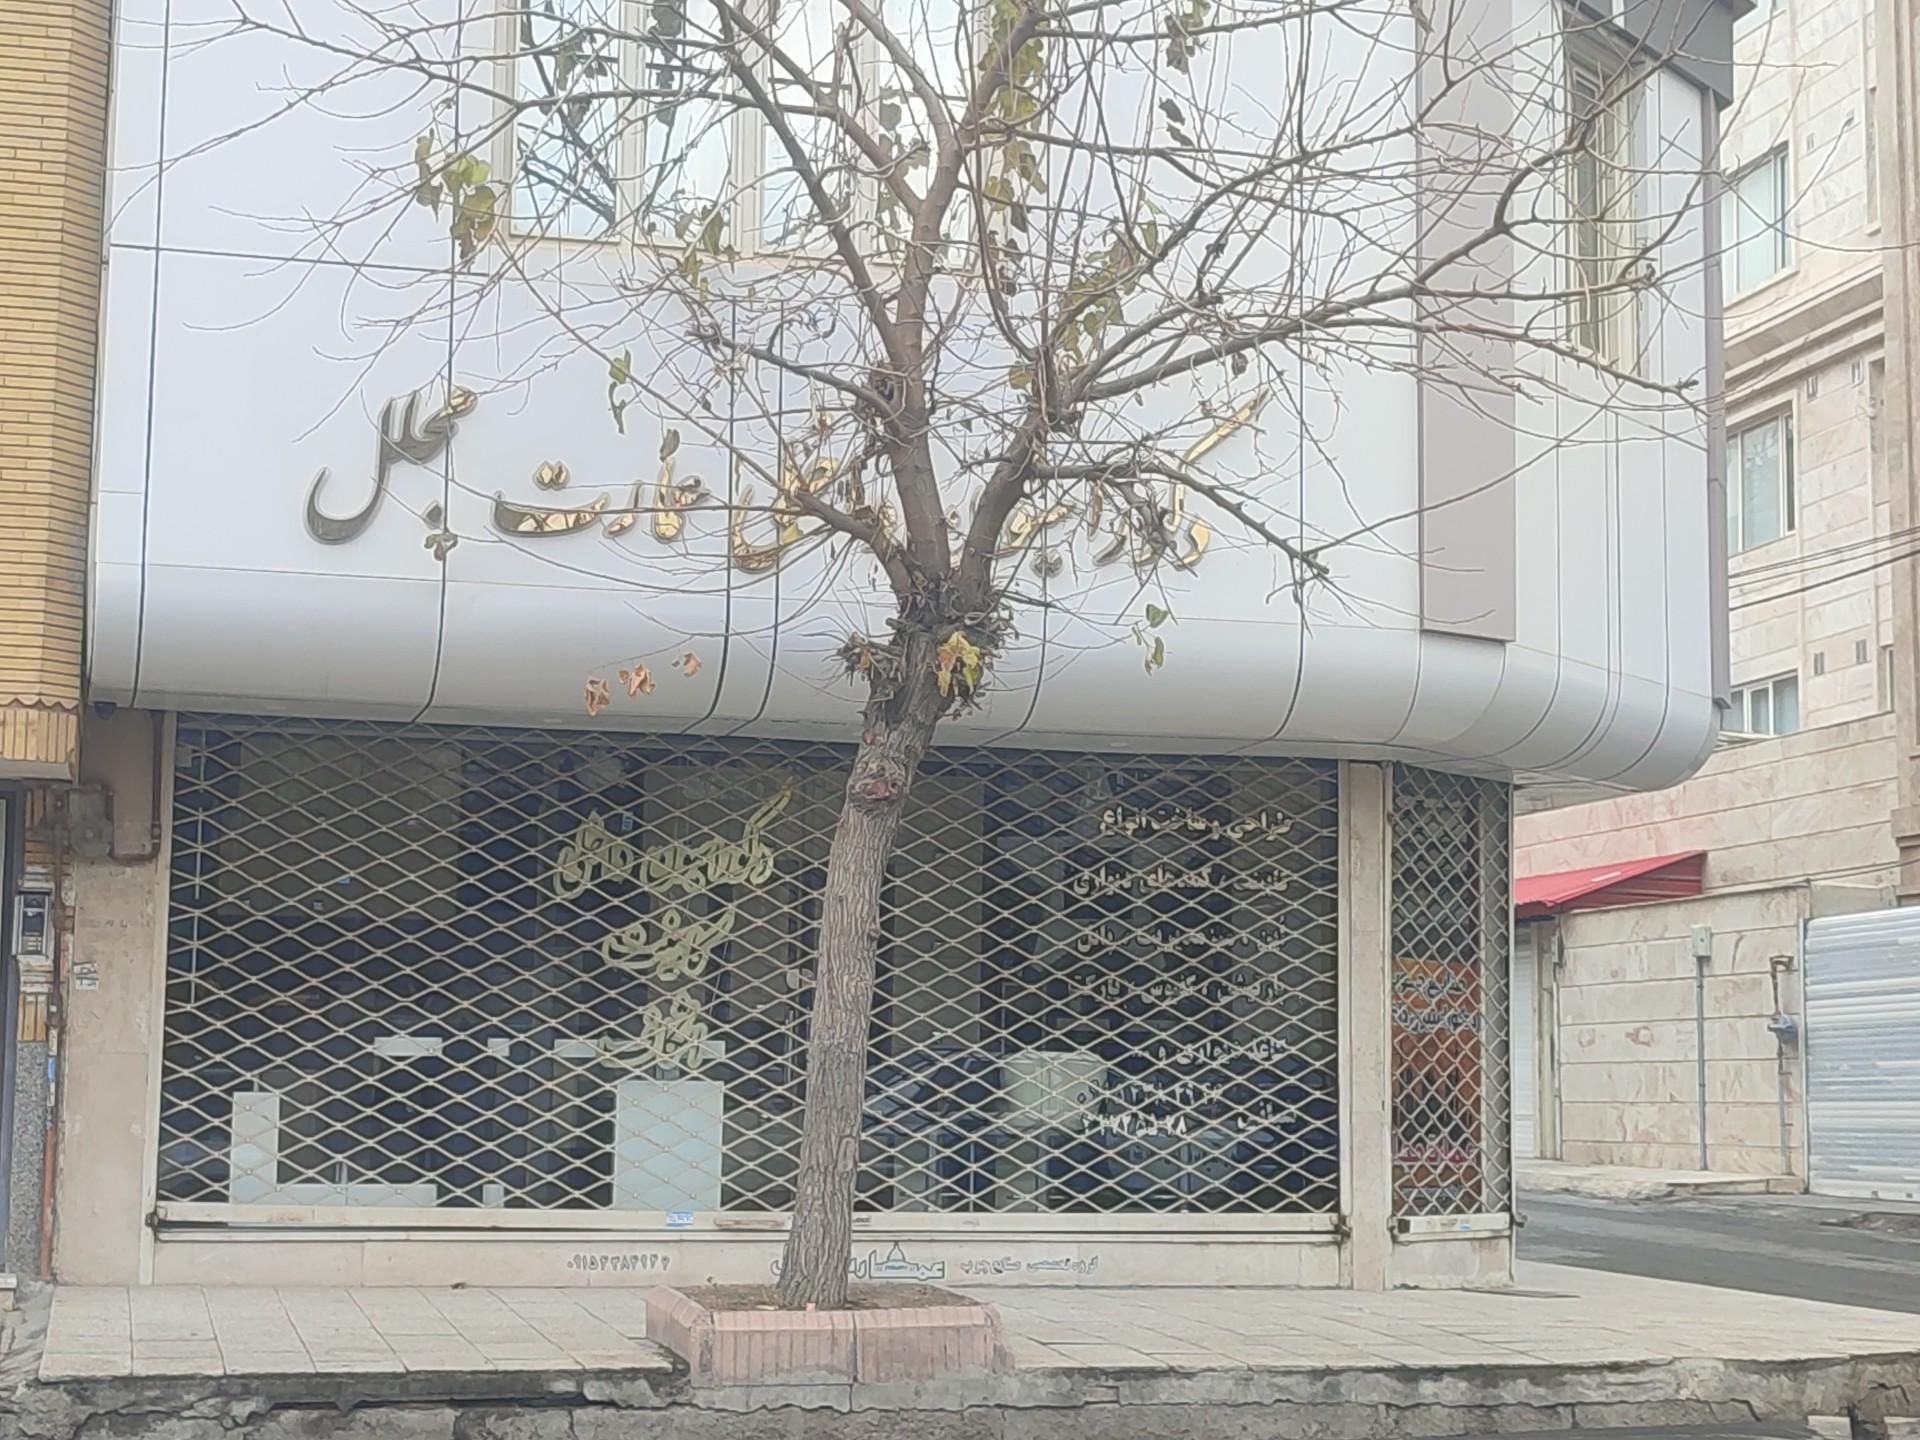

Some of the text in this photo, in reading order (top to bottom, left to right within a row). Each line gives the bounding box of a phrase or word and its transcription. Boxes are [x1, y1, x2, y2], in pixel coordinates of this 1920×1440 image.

[304, 384, 477, 545] مجلل
[493, 460, 709, 542] عمارت
[848, 1246, 946, 1282] عمار
